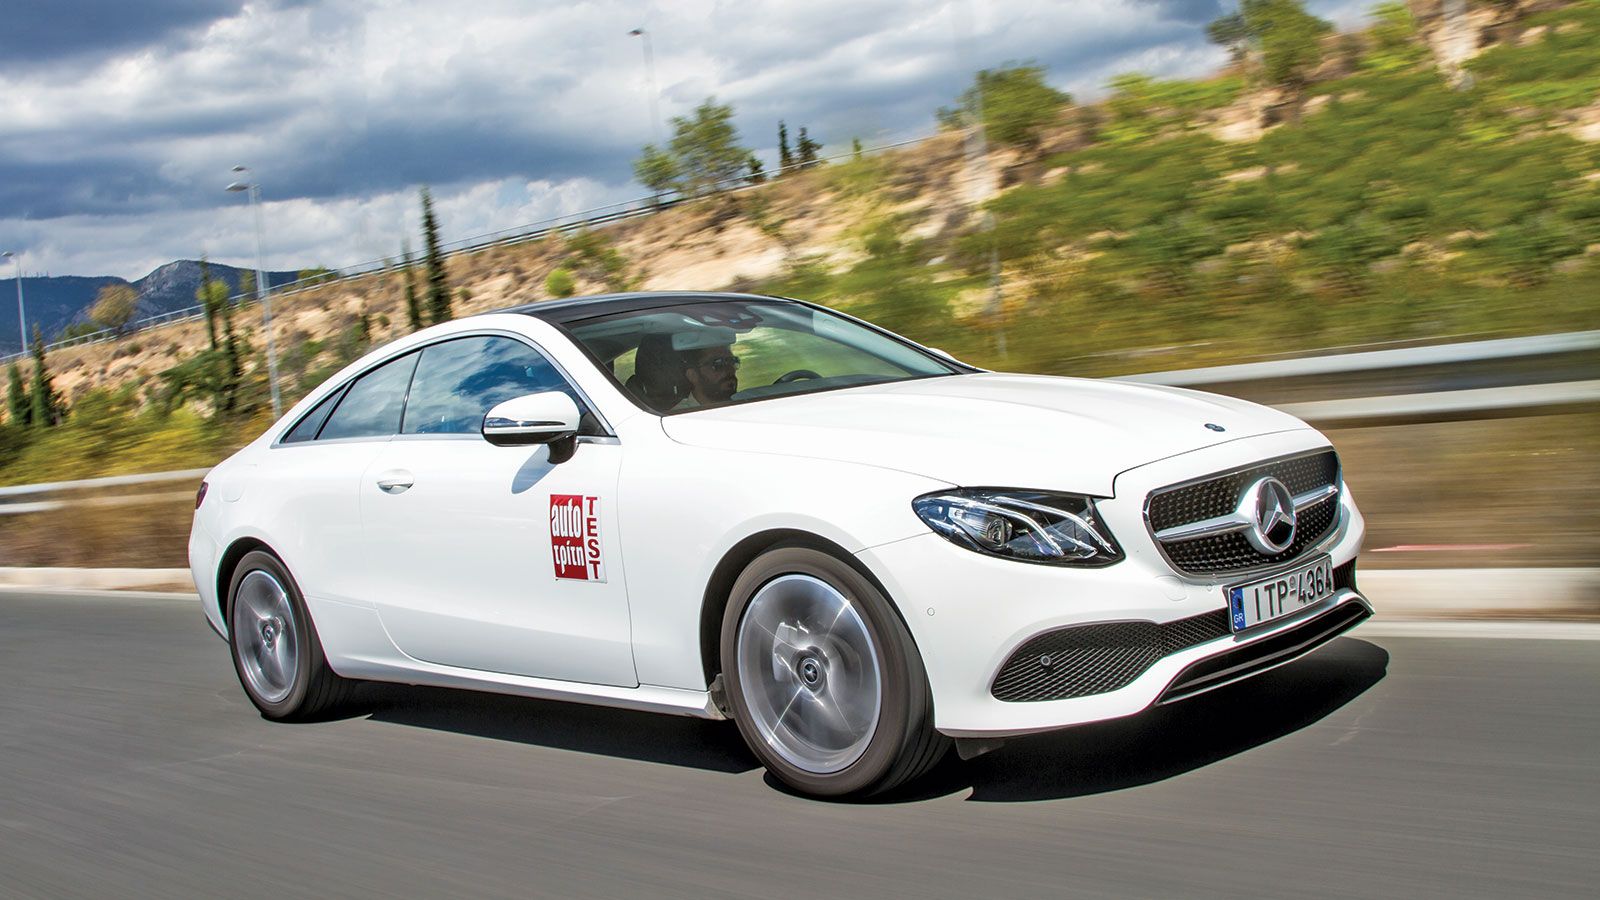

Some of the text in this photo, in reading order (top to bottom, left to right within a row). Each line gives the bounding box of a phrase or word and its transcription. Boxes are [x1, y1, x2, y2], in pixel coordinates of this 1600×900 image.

[551, 498, 582, 538] auto
[586, 496, 600, 579] TEST
[1233, 613, 1244, 623] GR
